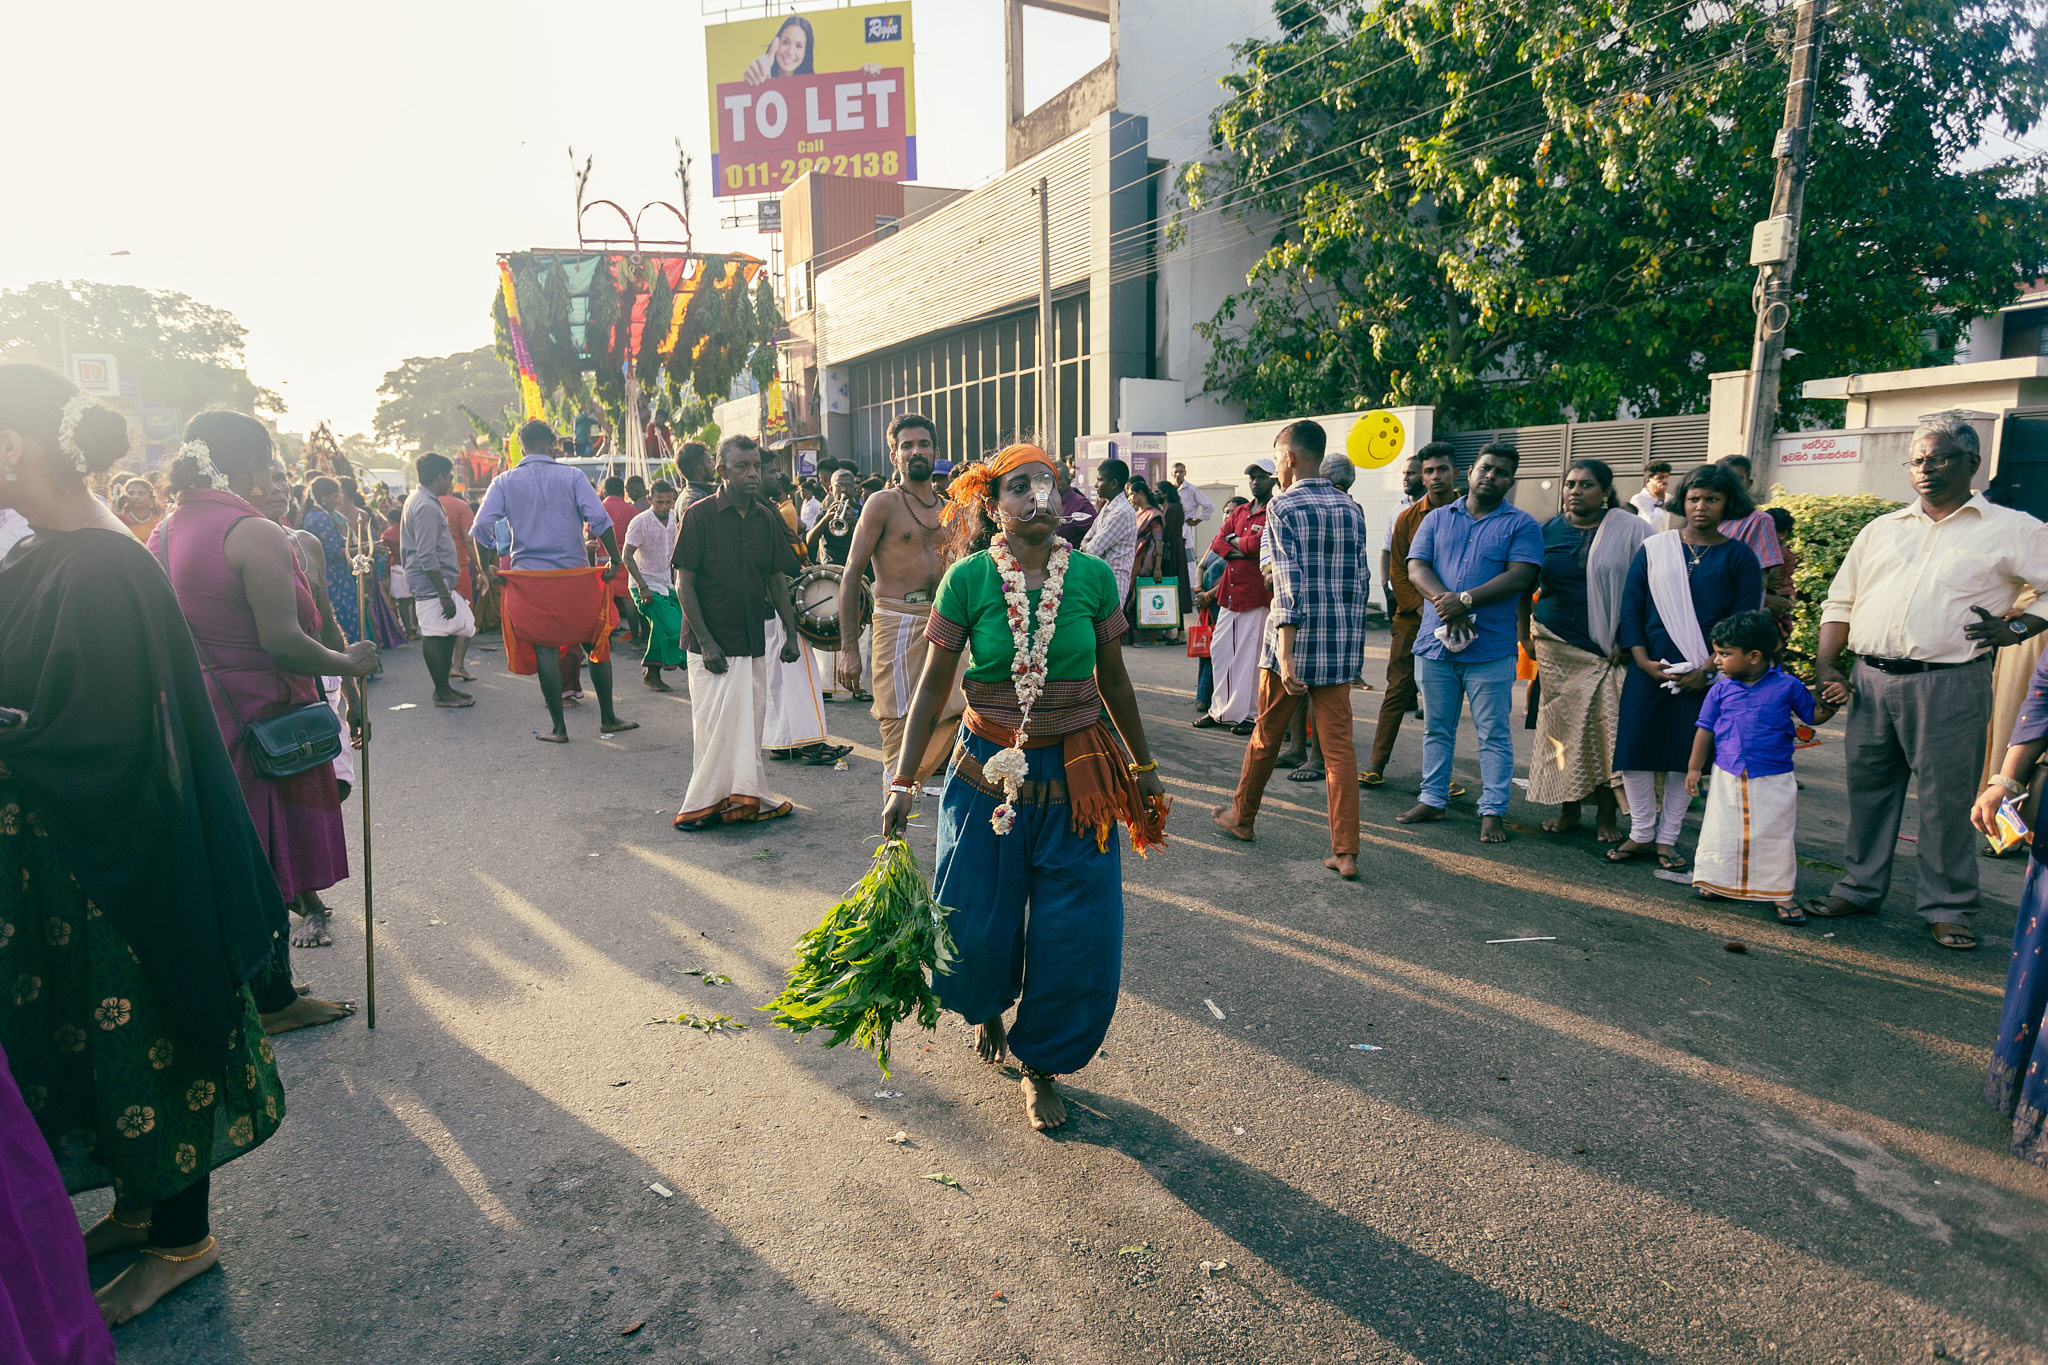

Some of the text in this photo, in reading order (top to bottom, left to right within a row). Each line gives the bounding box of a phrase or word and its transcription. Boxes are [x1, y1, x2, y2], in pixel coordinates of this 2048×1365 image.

[724, 79, 897, 142] TO LET
[797, 139, 824, 154] Call
